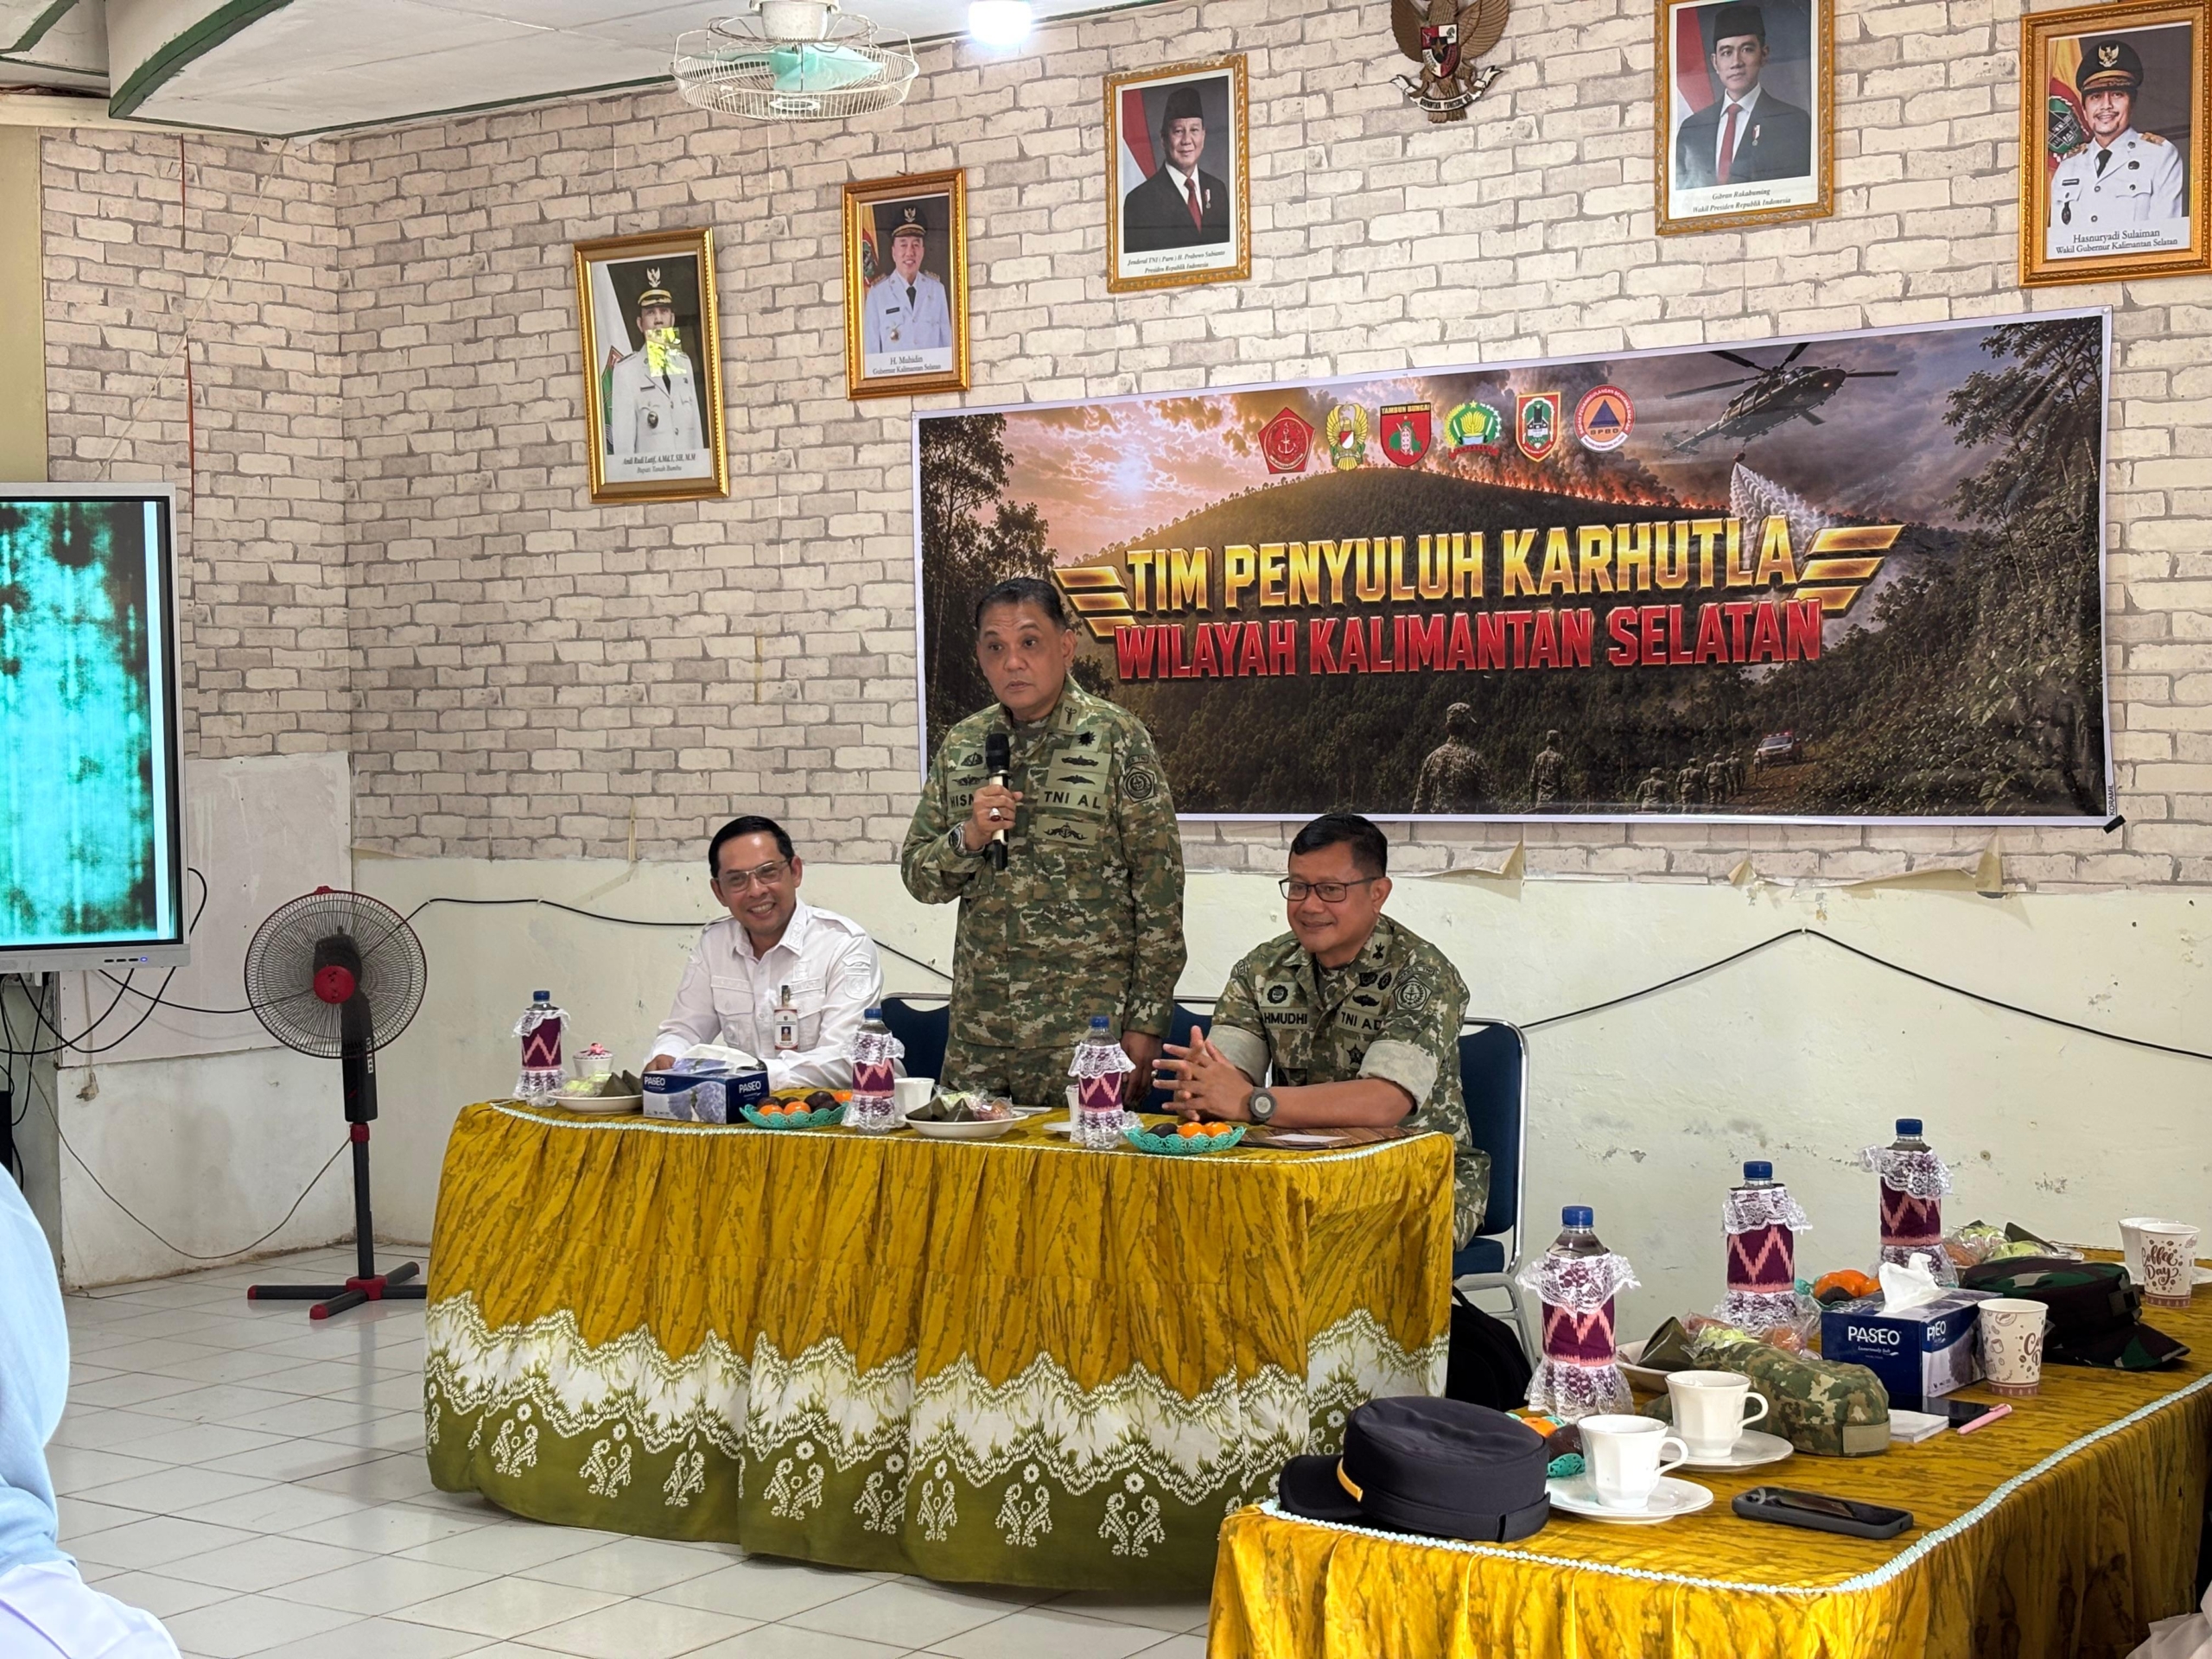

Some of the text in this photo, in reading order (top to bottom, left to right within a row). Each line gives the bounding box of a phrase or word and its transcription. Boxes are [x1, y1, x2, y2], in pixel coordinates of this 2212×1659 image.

[1733, 188, 1770, 199] Rakabuming
[1710, 202, 1734, 212] Presiden
[1735, 200, 1761, 210] Republik
[1762, 197, 1791, 206] Indonesia
[2073, 228, 2160, 244] Hasnuryadi Sulaiman
[2056, 238, 2177, 255] Wakil Gubernur Kalimantan Selatan
[1125, 515, 1797, 614] TIM PENYULUH KARHUTLA
[1114, 598, 1823, 679] WILAYAH KALIMANTAN SELATAN
[1044, 791, 1070, 804] TNI
[1341, 1011, 1357, 1027] TNI
[644, 1076, 665, 1086] PASEO
[739, 1080, 761, 1094] PASEO
[2142, 1244, 2178, 1267] Coffee
[2145, 1264, 2179, 1286] Day
[1847, 1325, 1901, 1345] PASEO
